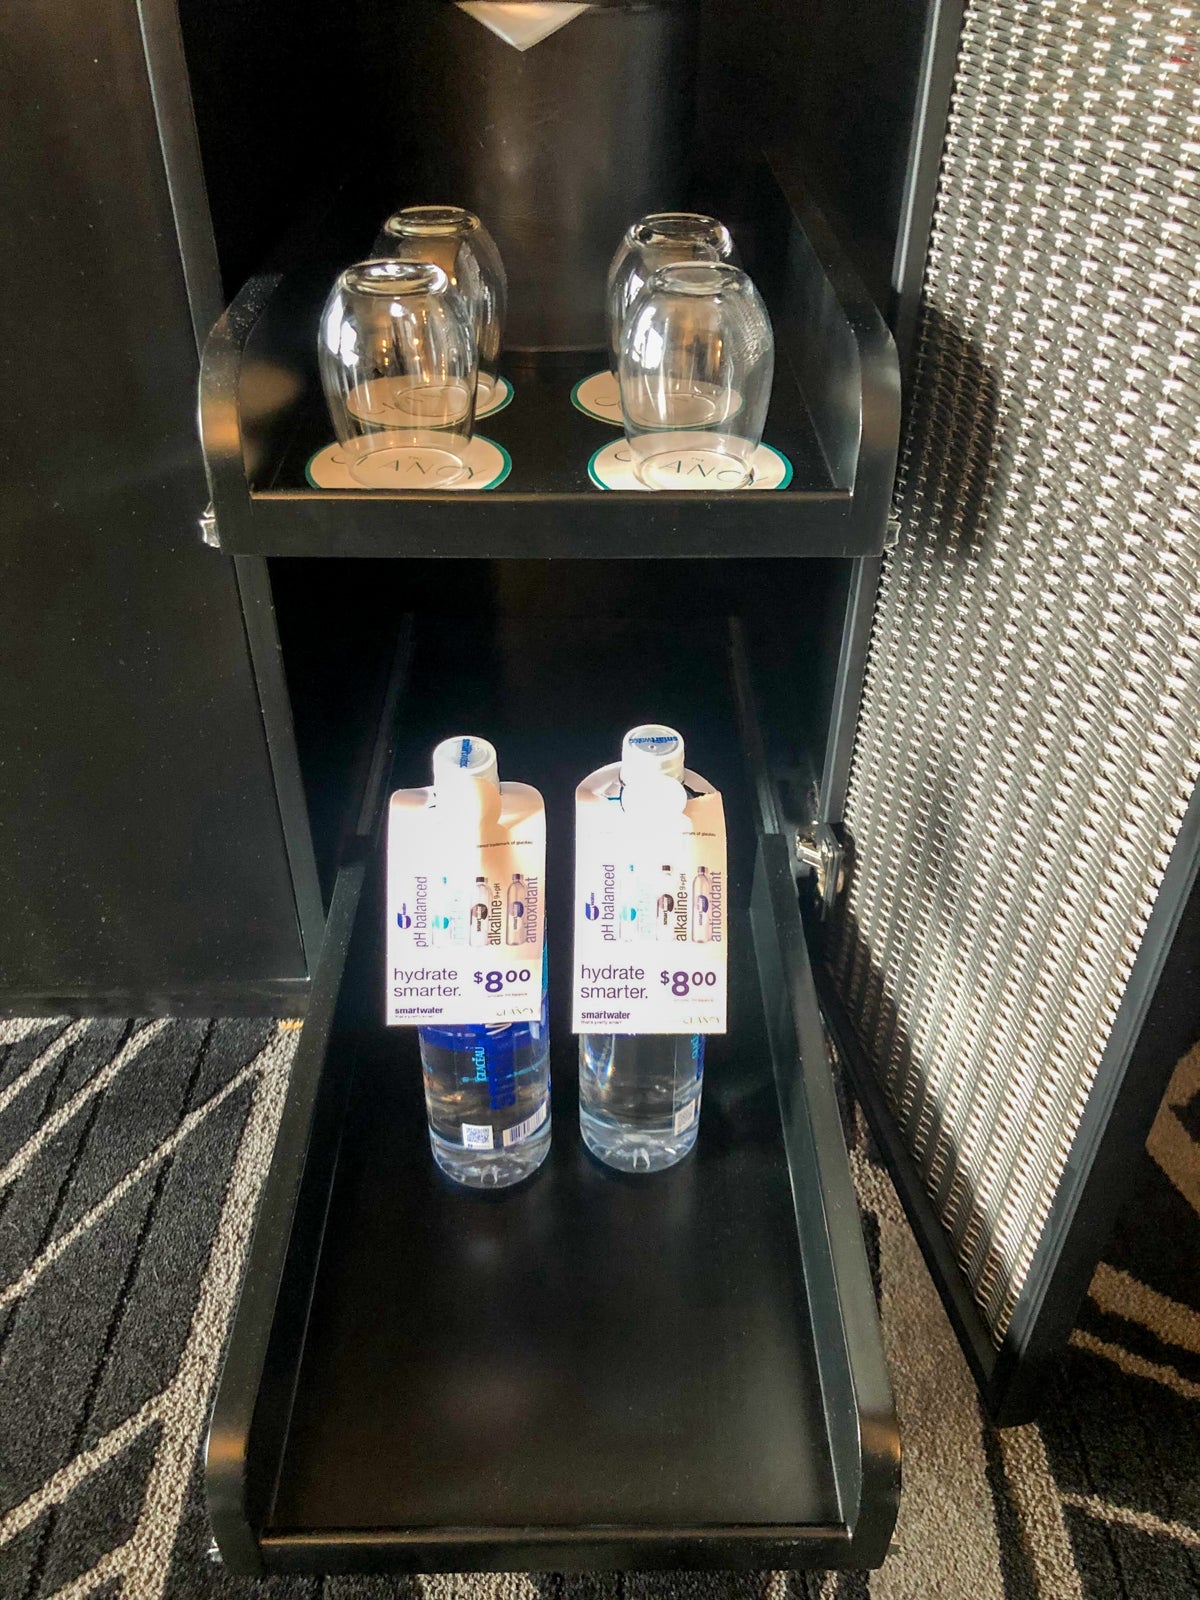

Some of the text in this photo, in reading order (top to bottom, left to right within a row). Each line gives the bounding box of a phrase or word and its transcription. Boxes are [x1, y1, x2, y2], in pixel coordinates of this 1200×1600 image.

[413, 876, 429, 948] pH balanced
[487, 900, 503, 946] alkaline
[524, 877, 538, 943] antioxidant
[601, 864, 617, 941] pH balanced
[674, 891, 688, 942] alkaline
[709, 871, 722, 943] antioxidant
[393, 967, 458, 984] hydrate
[393, 984, 462, 997] smarter.
[580, 985, 648, 999] smarter.
[581, 964, 645, 983] hydrate
[581, 1010, 631, 1019] smartwater
[472, 1046, 487, 1082] GLACÉAU
